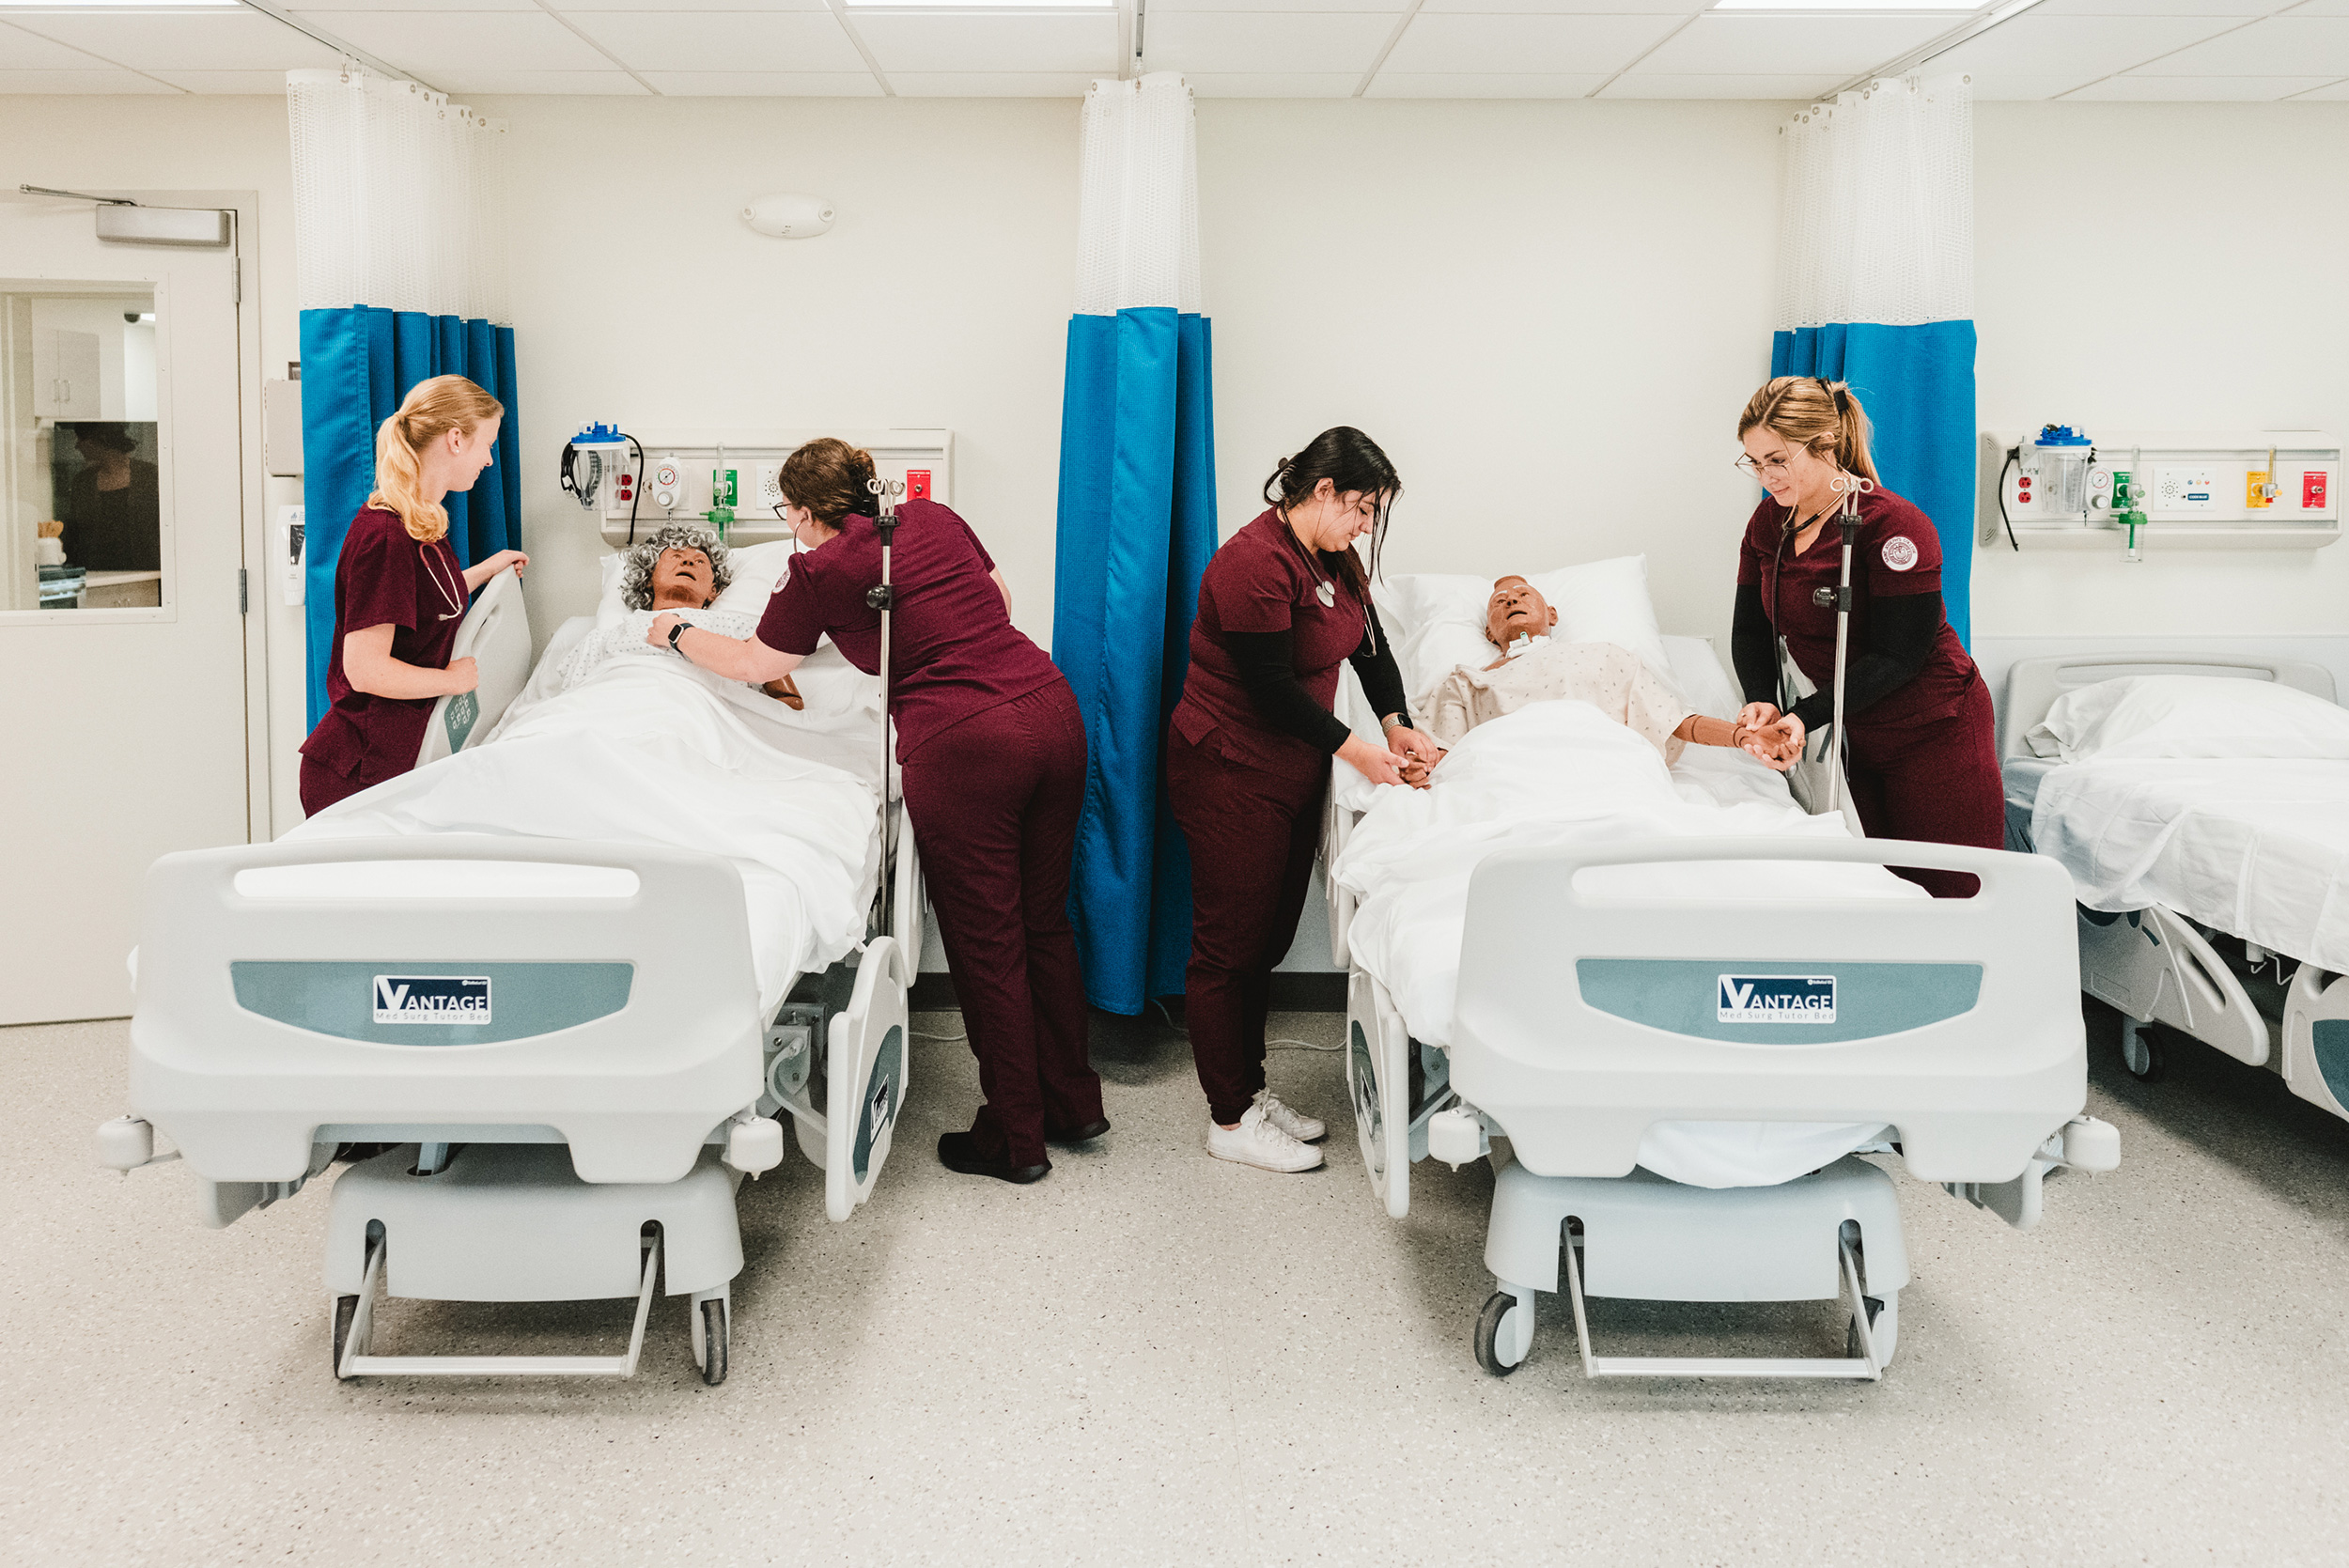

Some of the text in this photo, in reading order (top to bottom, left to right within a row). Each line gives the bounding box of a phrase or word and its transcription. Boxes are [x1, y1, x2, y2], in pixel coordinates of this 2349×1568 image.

[377, 978, 487, 1011] VANTAGE
[1720, 977, 1831, 1010] VANTAGE
[404, 1013, 428, 1021] Surg
[1748, 1011, 1773, 1020] Surg
[1779, 1011, 1809, 1019] Tutor
